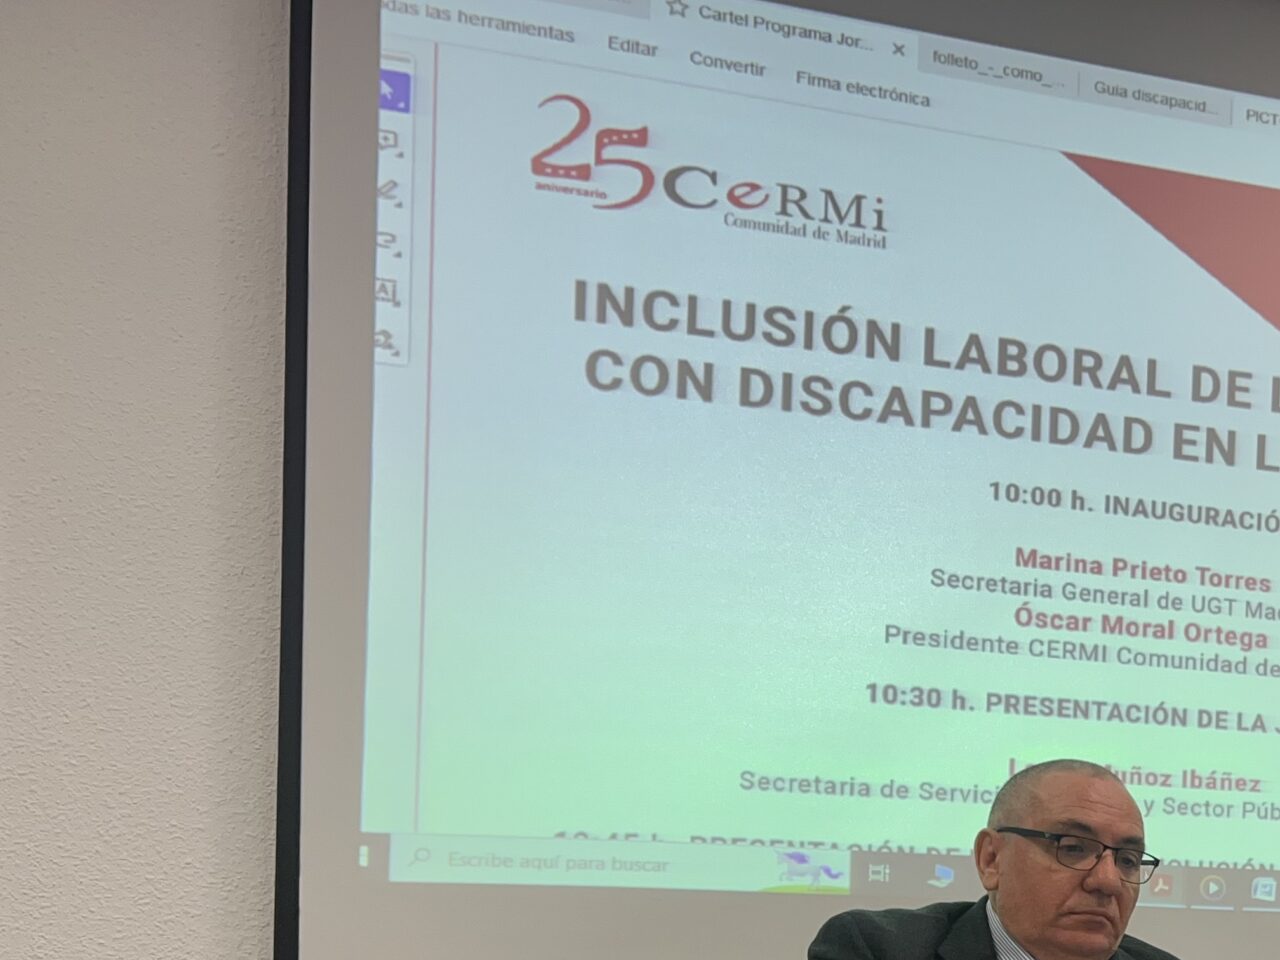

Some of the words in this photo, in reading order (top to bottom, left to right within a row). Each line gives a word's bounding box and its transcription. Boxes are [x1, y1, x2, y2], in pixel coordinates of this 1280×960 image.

[425, 5, 451, 21] las
[457, 10, 575, 43] herramientas
[699, 6, 749, 27] Cartel
[753, 16, 832, 44] Programa
[608, 35, 658, 58] Editar
[690, 50, 767, 78] Convertir
[797, 70, 841, 91] Firma
[846, 80, 931, 108] electrónica
[531, 94, 655, 211] 25
[535, 181, 608, 201] aniversario
[723, 211, 807, 239] Comunidad
[813, 226, 830, 242] de
[835, 228, 887, 250] Madrid
[574, 279, 900, 362] INCLUSIÓN
[923, 327, 1172, 399] LABORAL
[1191, 364, 1253, 410] DE
[585, 349, 715, 402] CON
[739, 366, 1153, 455] DISCAPACIDAD
[1172, 422, 1236, 467] EN
[988, 480, 1062, 508] 10:00
[1070, 490, 1094, 512] h.
[1016, 547, 1104, 575] Marina
[1112, 558, 1187, 585] Prieto
[1195, 565, 1272, 593] Torres
[930, 568, 1053, 599] Secretaria
[1061, 581, 1149, 608] General
[1157, 591, 1184, 611] de
[1191, 594, 1237, 616] UGT
[1014, 602, 1092, 632] Óscar
[1100, 614, 1175, 641] Moral
[1183, 622, 1269, 652] Ortega
[884, 624, 1020, 656] Presidente
[1028, 637, 1108, 664] CERMI
[1116, 647, 1248, 676] Comunidad
[866, 682, 942, 710] 10:30
[951, 688, 976, 711] h.
[986, 692, 1188, 729] PRESENTACIÓN
[1196, 707, 1229, 732] DE
[1236, 711, 1267, 735] LA
[740, 770, 871, 799] Secretaria
[880, 778, 909, 800] de
[919, 781, 1000, 805] Servici
[1143, 800, 1155, 818] y
[1161, 797, 1235, 820] Sector
[1181, 766, 1262, 793] Ibáñez
[448, 852, 514, 869] Escribe
[519, 855, 560, 871] aquí
[565, 858, 605, 872] para
[611, 856, 669, 873] buscar
